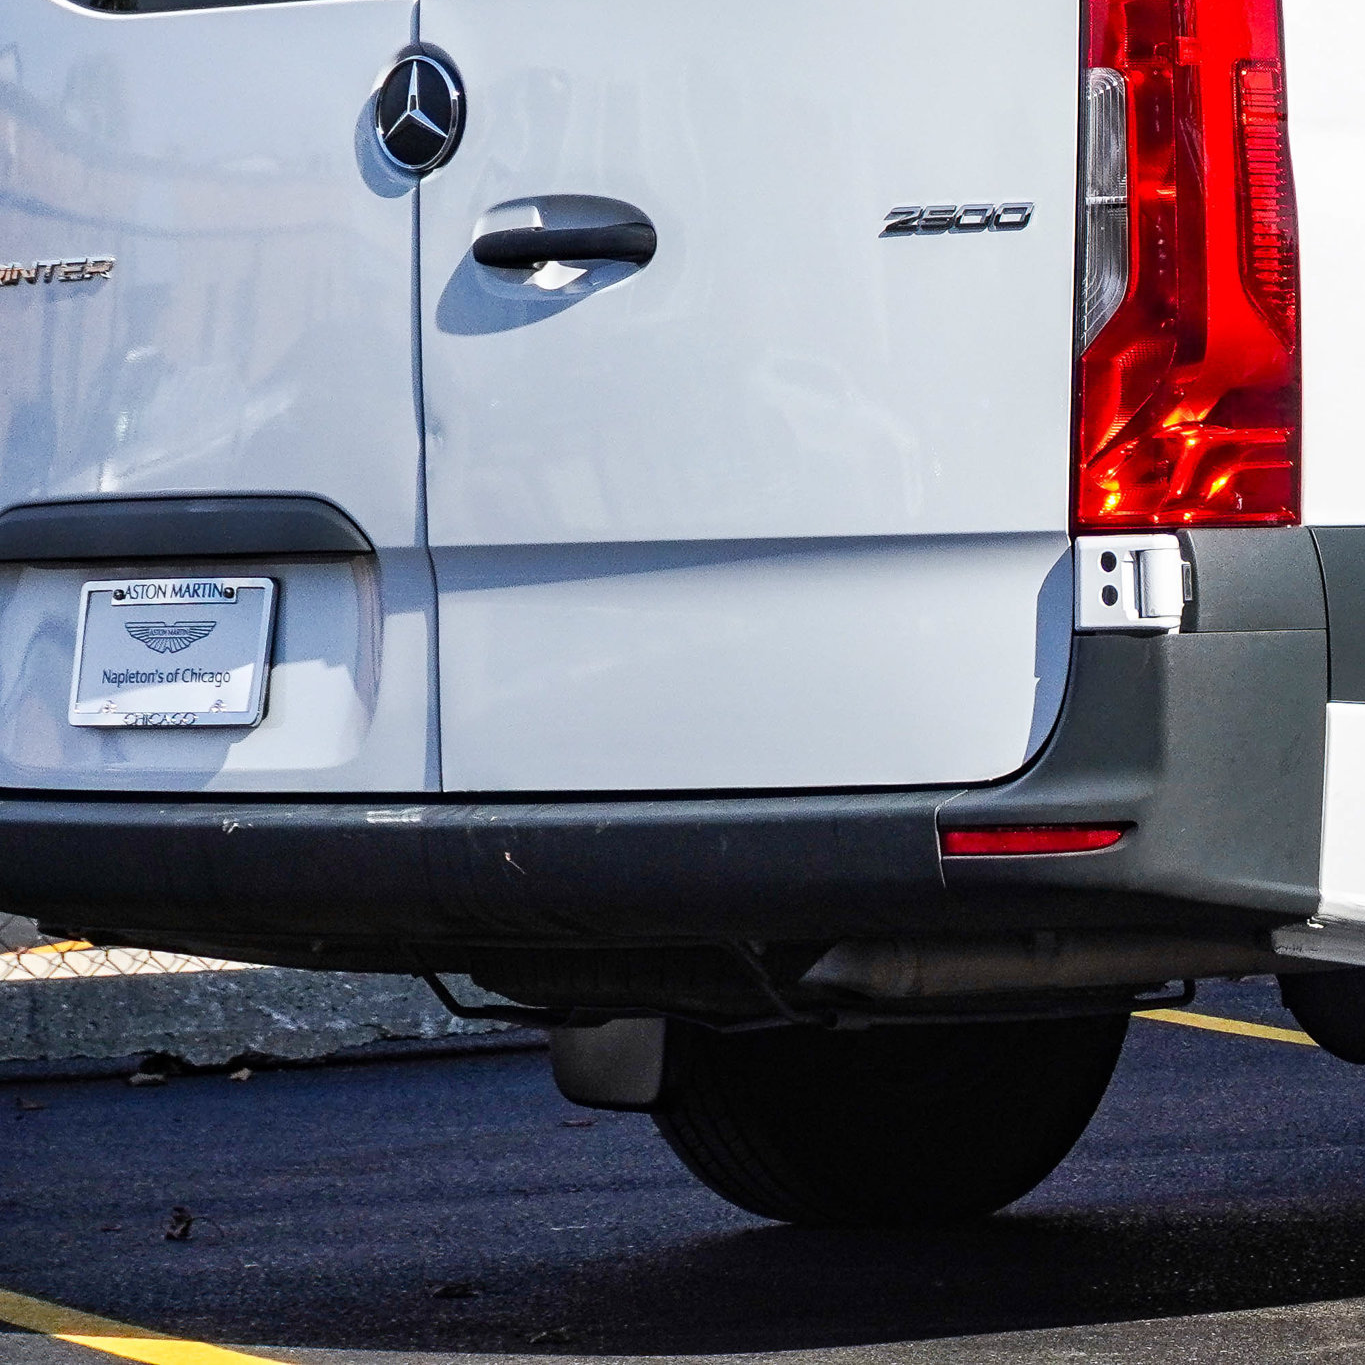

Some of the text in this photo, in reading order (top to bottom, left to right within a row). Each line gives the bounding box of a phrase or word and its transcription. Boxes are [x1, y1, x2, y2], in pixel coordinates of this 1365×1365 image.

[878, 201, 1036, 239] 2500
[125, 582, 224, 600] ASTON MARTIN
[102, 668, 231, 689] Napleton's of Chicago
